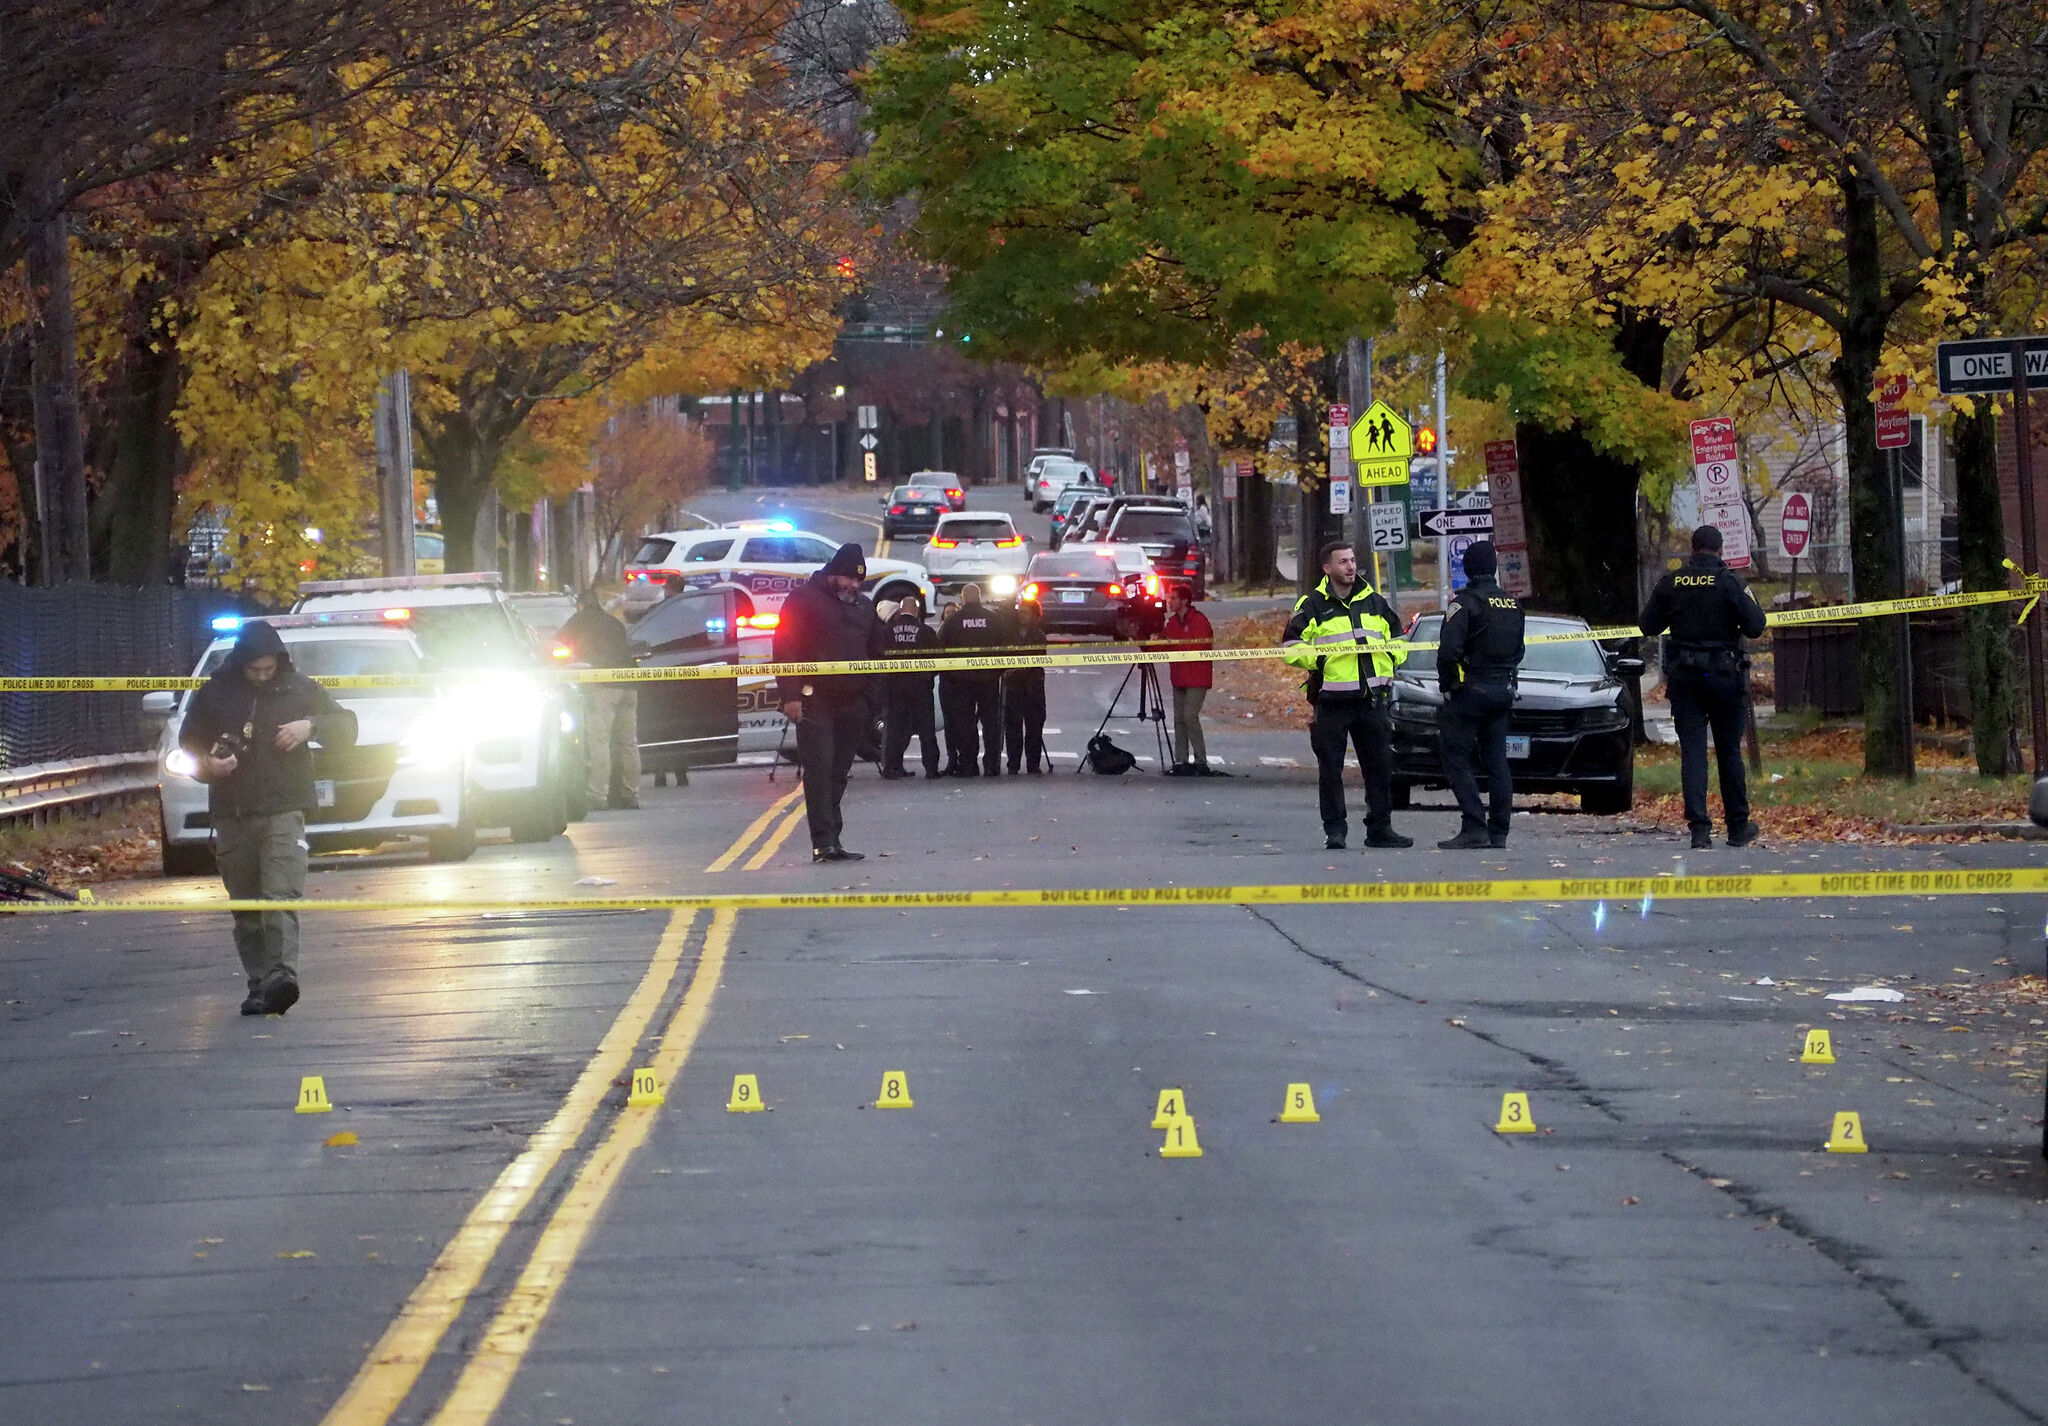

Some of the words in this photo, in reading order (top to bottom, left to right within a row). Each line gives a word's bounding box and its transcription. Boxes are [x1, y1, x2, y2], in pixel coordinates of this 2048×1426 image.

[1964, 356, 2004, 377] ONE
[1878, 415, 1908, 430] Anytime
[1703, 435, 1723, 445] Snow
[1696, 444, 1733, 455] Emergency
[1705, 454, 1726, 462] Route
[1366, 466, 1402, 480] AHEAD
[1704, 492, 1738, 502] Declared
[1372, 507, 1402, 516] SPEED
[1718, 510, 1729, 519] NO
[1786, 507, 1794, 516] DO
[1796, 506, 1807, 514] NOT
[1376, 518, 1398, 526] LIMIT
[1436, 518, 1455, 528] ONE
[1469, 516, 1488, 526] WAY
[1374, 528, 1404, 546] 25
[1786, 534, 1804, 544] ENTER
[1674, 576, 1716, 586] POLICE
[1488, 598, 1518, 609] POLICE
[1892, 600, 1915, 611] POLICE
[1916, 598, 1930, 609] LINE
[1932, 597, 1941, 607] DO
[1942, 596, 1955, 606] NOT
[1957, 594, 1978, 605] CROSS
[1776, 611, 1800, 622] POLICE
[1801, 610, 1815, 620] LINE
[1816, 609, 1826, 619] DO
[1827, 608, 1840, 618] NOT
[1841, 606, 1863, 616] CROSS
[962, 618, 986, 628] POLICE
[894, 634, 916, 642] POLICE
[1611, 629, 1633, 637] CROSS
[1315, 645, 1338, 653] POLICE
[1365, 643, 1378, 651] NOT
[1380, 642, 1401, 650] CROSS
[1083, 654, 1106, 663] POLICE
[1107, 653, 1121, 662] LINE
[1123, 653, 1132, 662] DO
[1134, 653, 1146, 661] NOT
[1148, 652, 1170, 661] CROSS
[1200, 650, 1223, 659] POLICE
[1224, 649, 1238, 658] LINE
[1239, 649, 1249, 658] DO
[1250, 649, 1262, 657] NOT
[1264, 648, 1286, 657] CROSS
[848, 662, 872, 671] POLICE
[873, 661, 887, 670] LINE
[889, 661, 898, 670] DO
[900, 660, 912, 670] NOT
[914, 660, 936, 669] CROSS
[966, 657, 989, 667] POLICE
[990, 657, 1005, 666] LINE
[1006, 657, 1016, 666] DO
[1017, 656, 1030, 665] NOT
[1031, 656, 1053, 665] CROSS
[611, 669, 635, 679] POLICE
[636, 669, 651, 678] LINE
[652, 668, 662, 678] DO
[663, 668, 676, 678] NOT
[678, 667, 700, 677] CROSS
[730, 665, 754, 676] POLICE
[755, 664, 770, 675] LINE
[771, 664, 781, 674] DO
[782, 664, 795, 674] NOT
[797, 663, 819, 673] CROSS
[3, 679, 27, 689] POLICE
[28, 679, 43, 689] LINE
[45, 679, 55, 689] DO
[56, 679, 70, 689] NOT
[72, 679, 94, 689] CROSS
[126, 680, 151, 689] POLICE
[152, 680, 167, 689] LINE
[169, 680, 178, 689] DO
[180, 679, 193, 689] NOT
[1810, 1042, 1825, 1054] 12
[636, 1077, 654, 1094] 10
[888, 1080, 900, 1099] 8
[304, 1088, 319, 1103] 11
[738, 1084, 750, 1101] 9
[1295, 1092, 1304, 1109] 5
[1163, 1098, 1176, 1116] 4
[1508, 1102, 1522, 1122] 3
[1844, 1121, 1853, 1139] 2
[1175, 1126, 1182, 1146] 1
